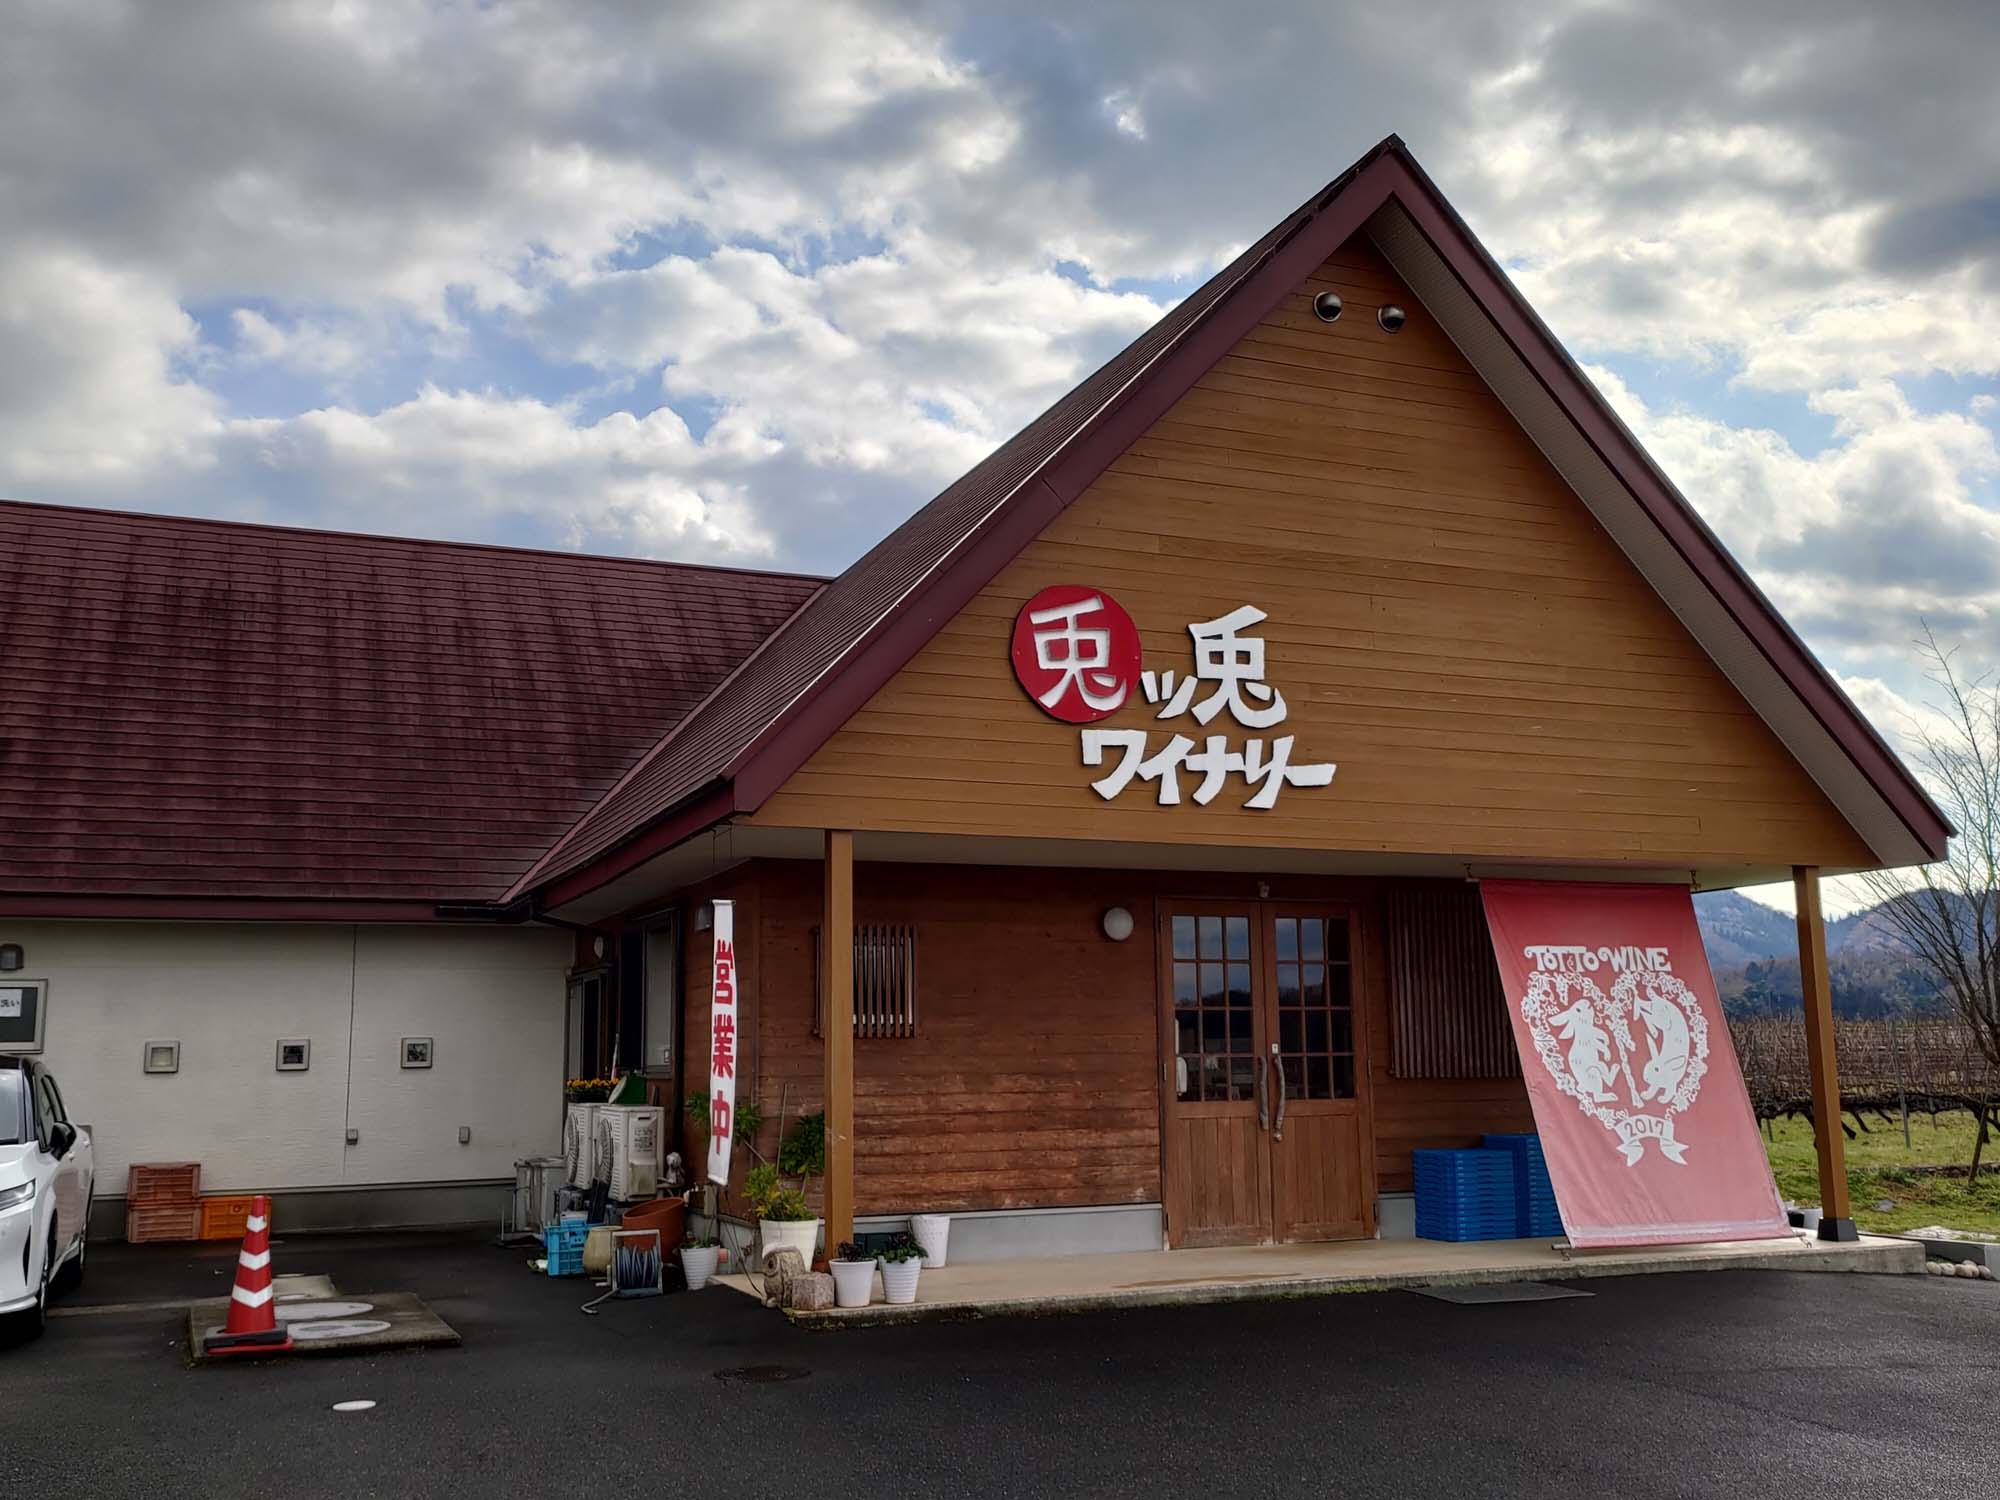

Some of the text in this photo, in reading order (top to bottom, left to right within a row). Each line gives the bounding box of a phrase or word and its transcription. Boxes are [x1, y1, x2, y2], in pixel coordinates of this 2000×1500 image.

[1081, 729, 1337, 810] ワイナリー
[1523, 945, 1672, 972] TOTTO WINE
[712, 938, 735, 1155] 営業中
[1624, 1118, 1665, 1137] 2017
